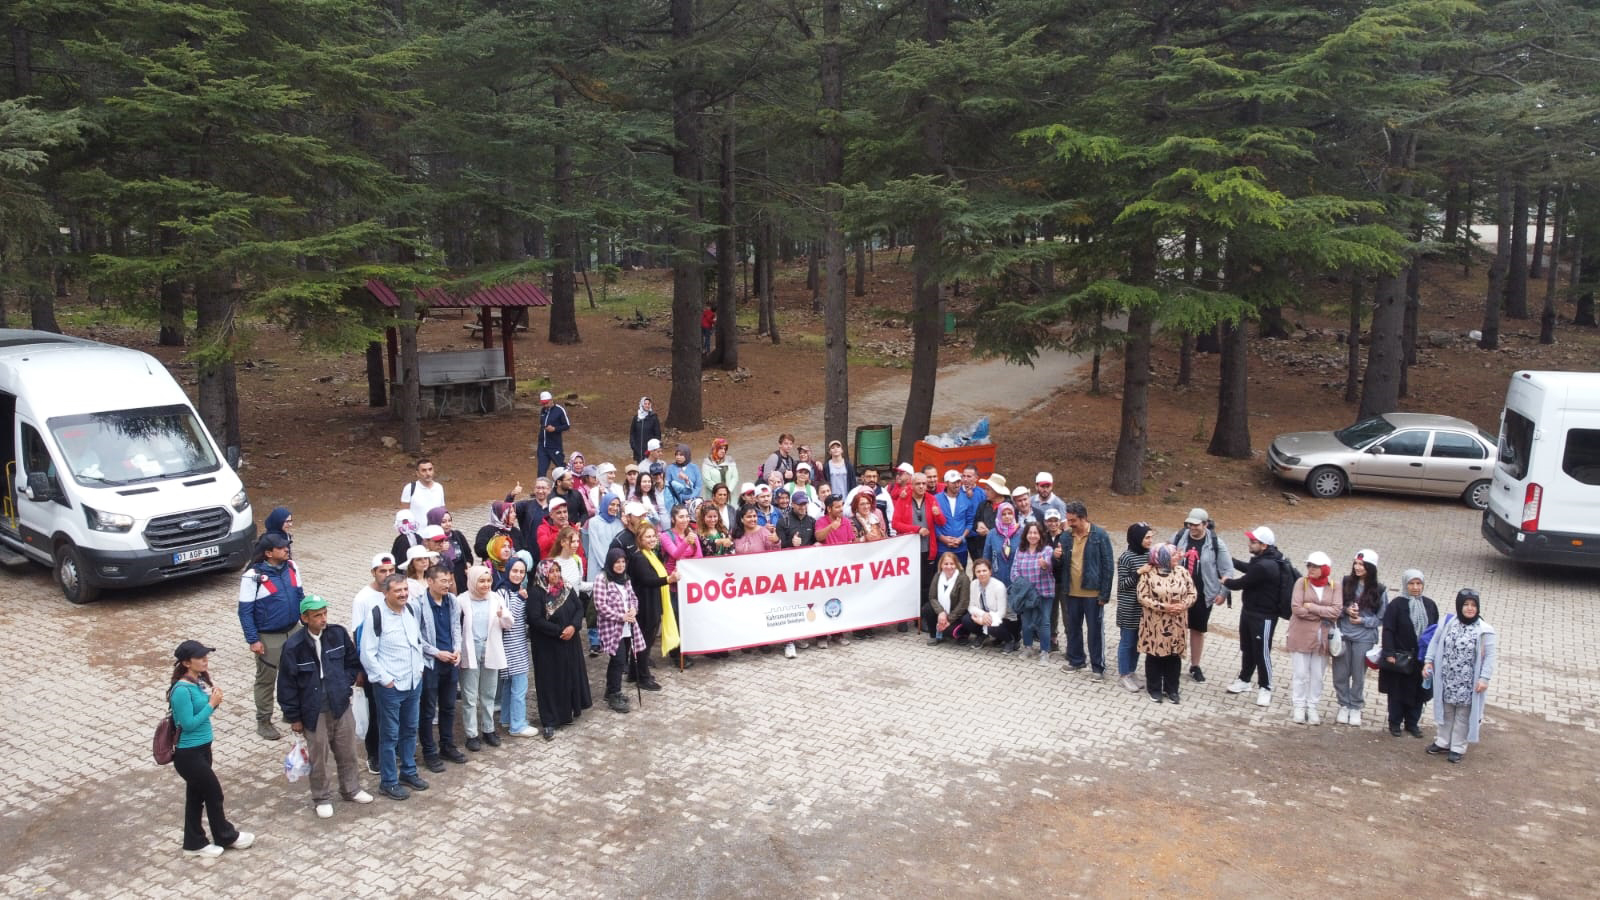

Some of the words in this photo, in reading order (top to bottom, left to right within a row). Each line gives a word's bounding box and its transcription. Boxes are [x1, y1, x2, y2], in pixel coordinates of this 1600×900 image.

[687, 573, 787, 604] DOĞADA
[794, 564, 864, 592] HAYAT
[869, 556, 910, 581] VAR
